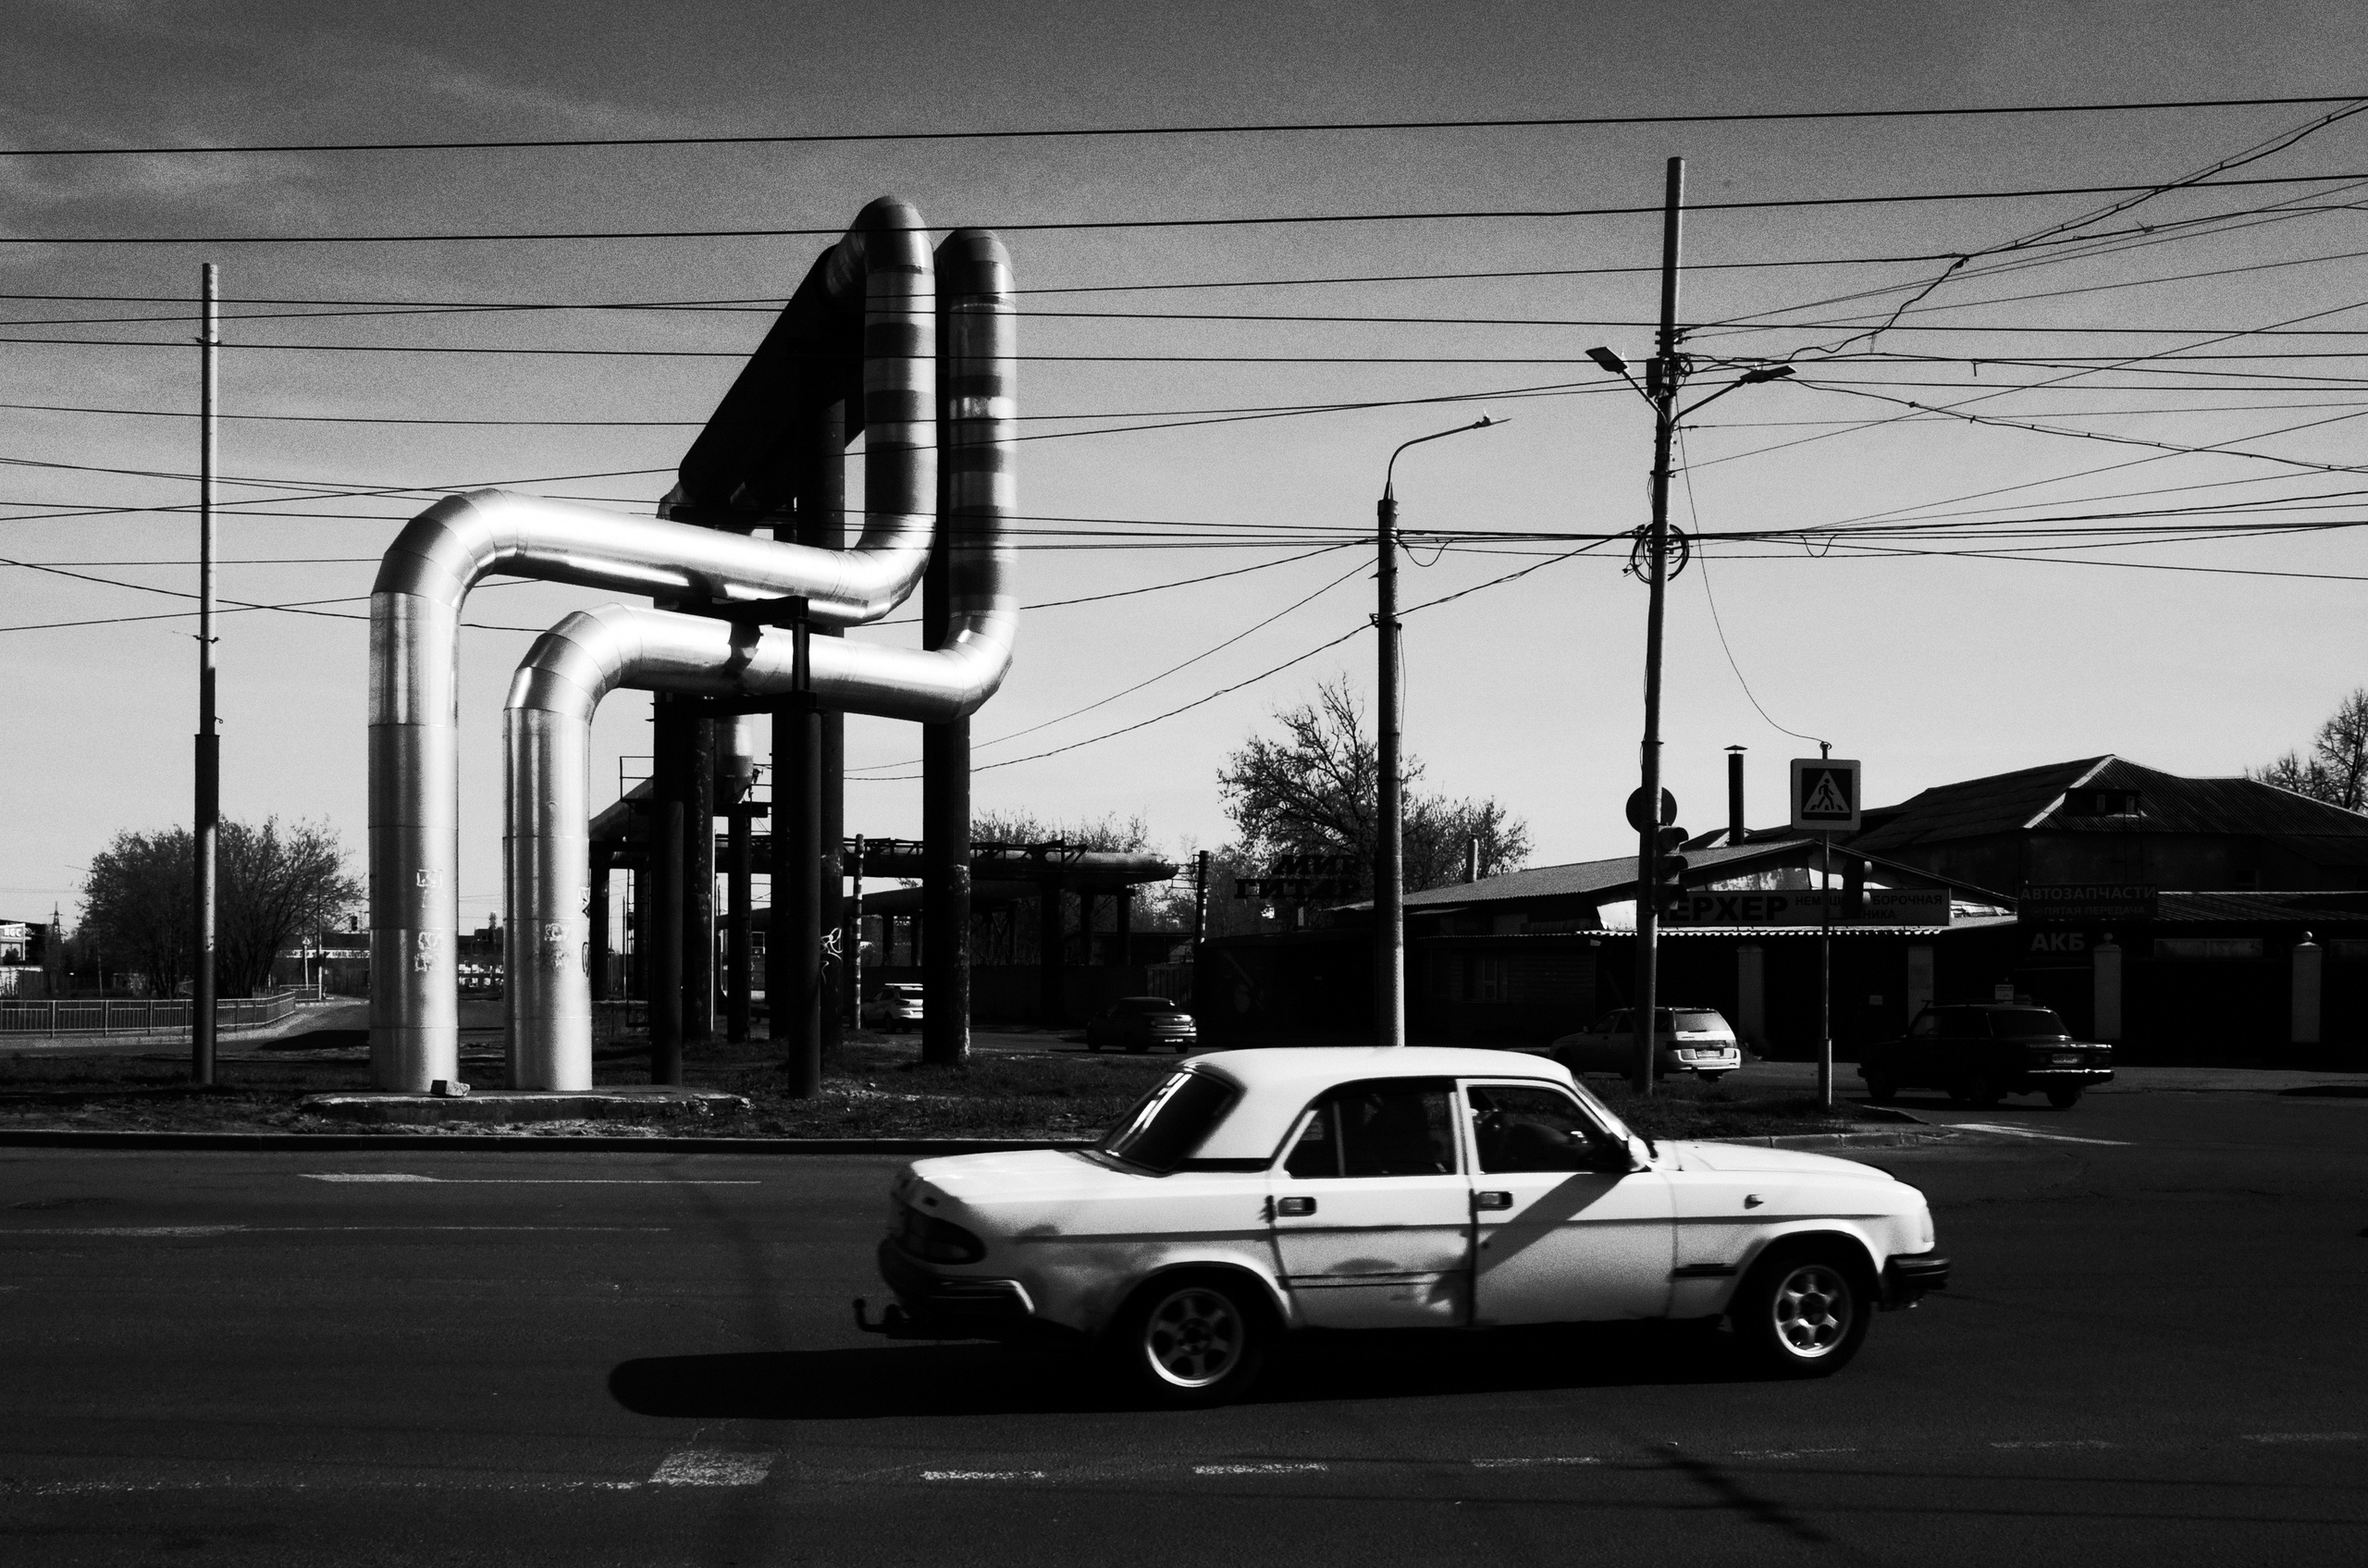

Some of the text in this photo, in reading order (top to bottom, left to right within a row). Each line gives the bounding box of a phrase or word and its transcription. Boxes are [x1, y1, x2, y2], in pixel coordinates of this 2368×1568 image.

[1272, 854, 1358, 874] МИР
[1235, 879, 1360, 899] ГИТАР
[2020, 885, 2156, 900] АВТОЗАПЧАСТИ
[1870, 894, 1942, 906] БОРОЧНАЯ
[2044, 906, 2145, 917] ПЯТАЯ ПЕРЕДАЧА
[2030, 932, 2085, 952] АКБ
